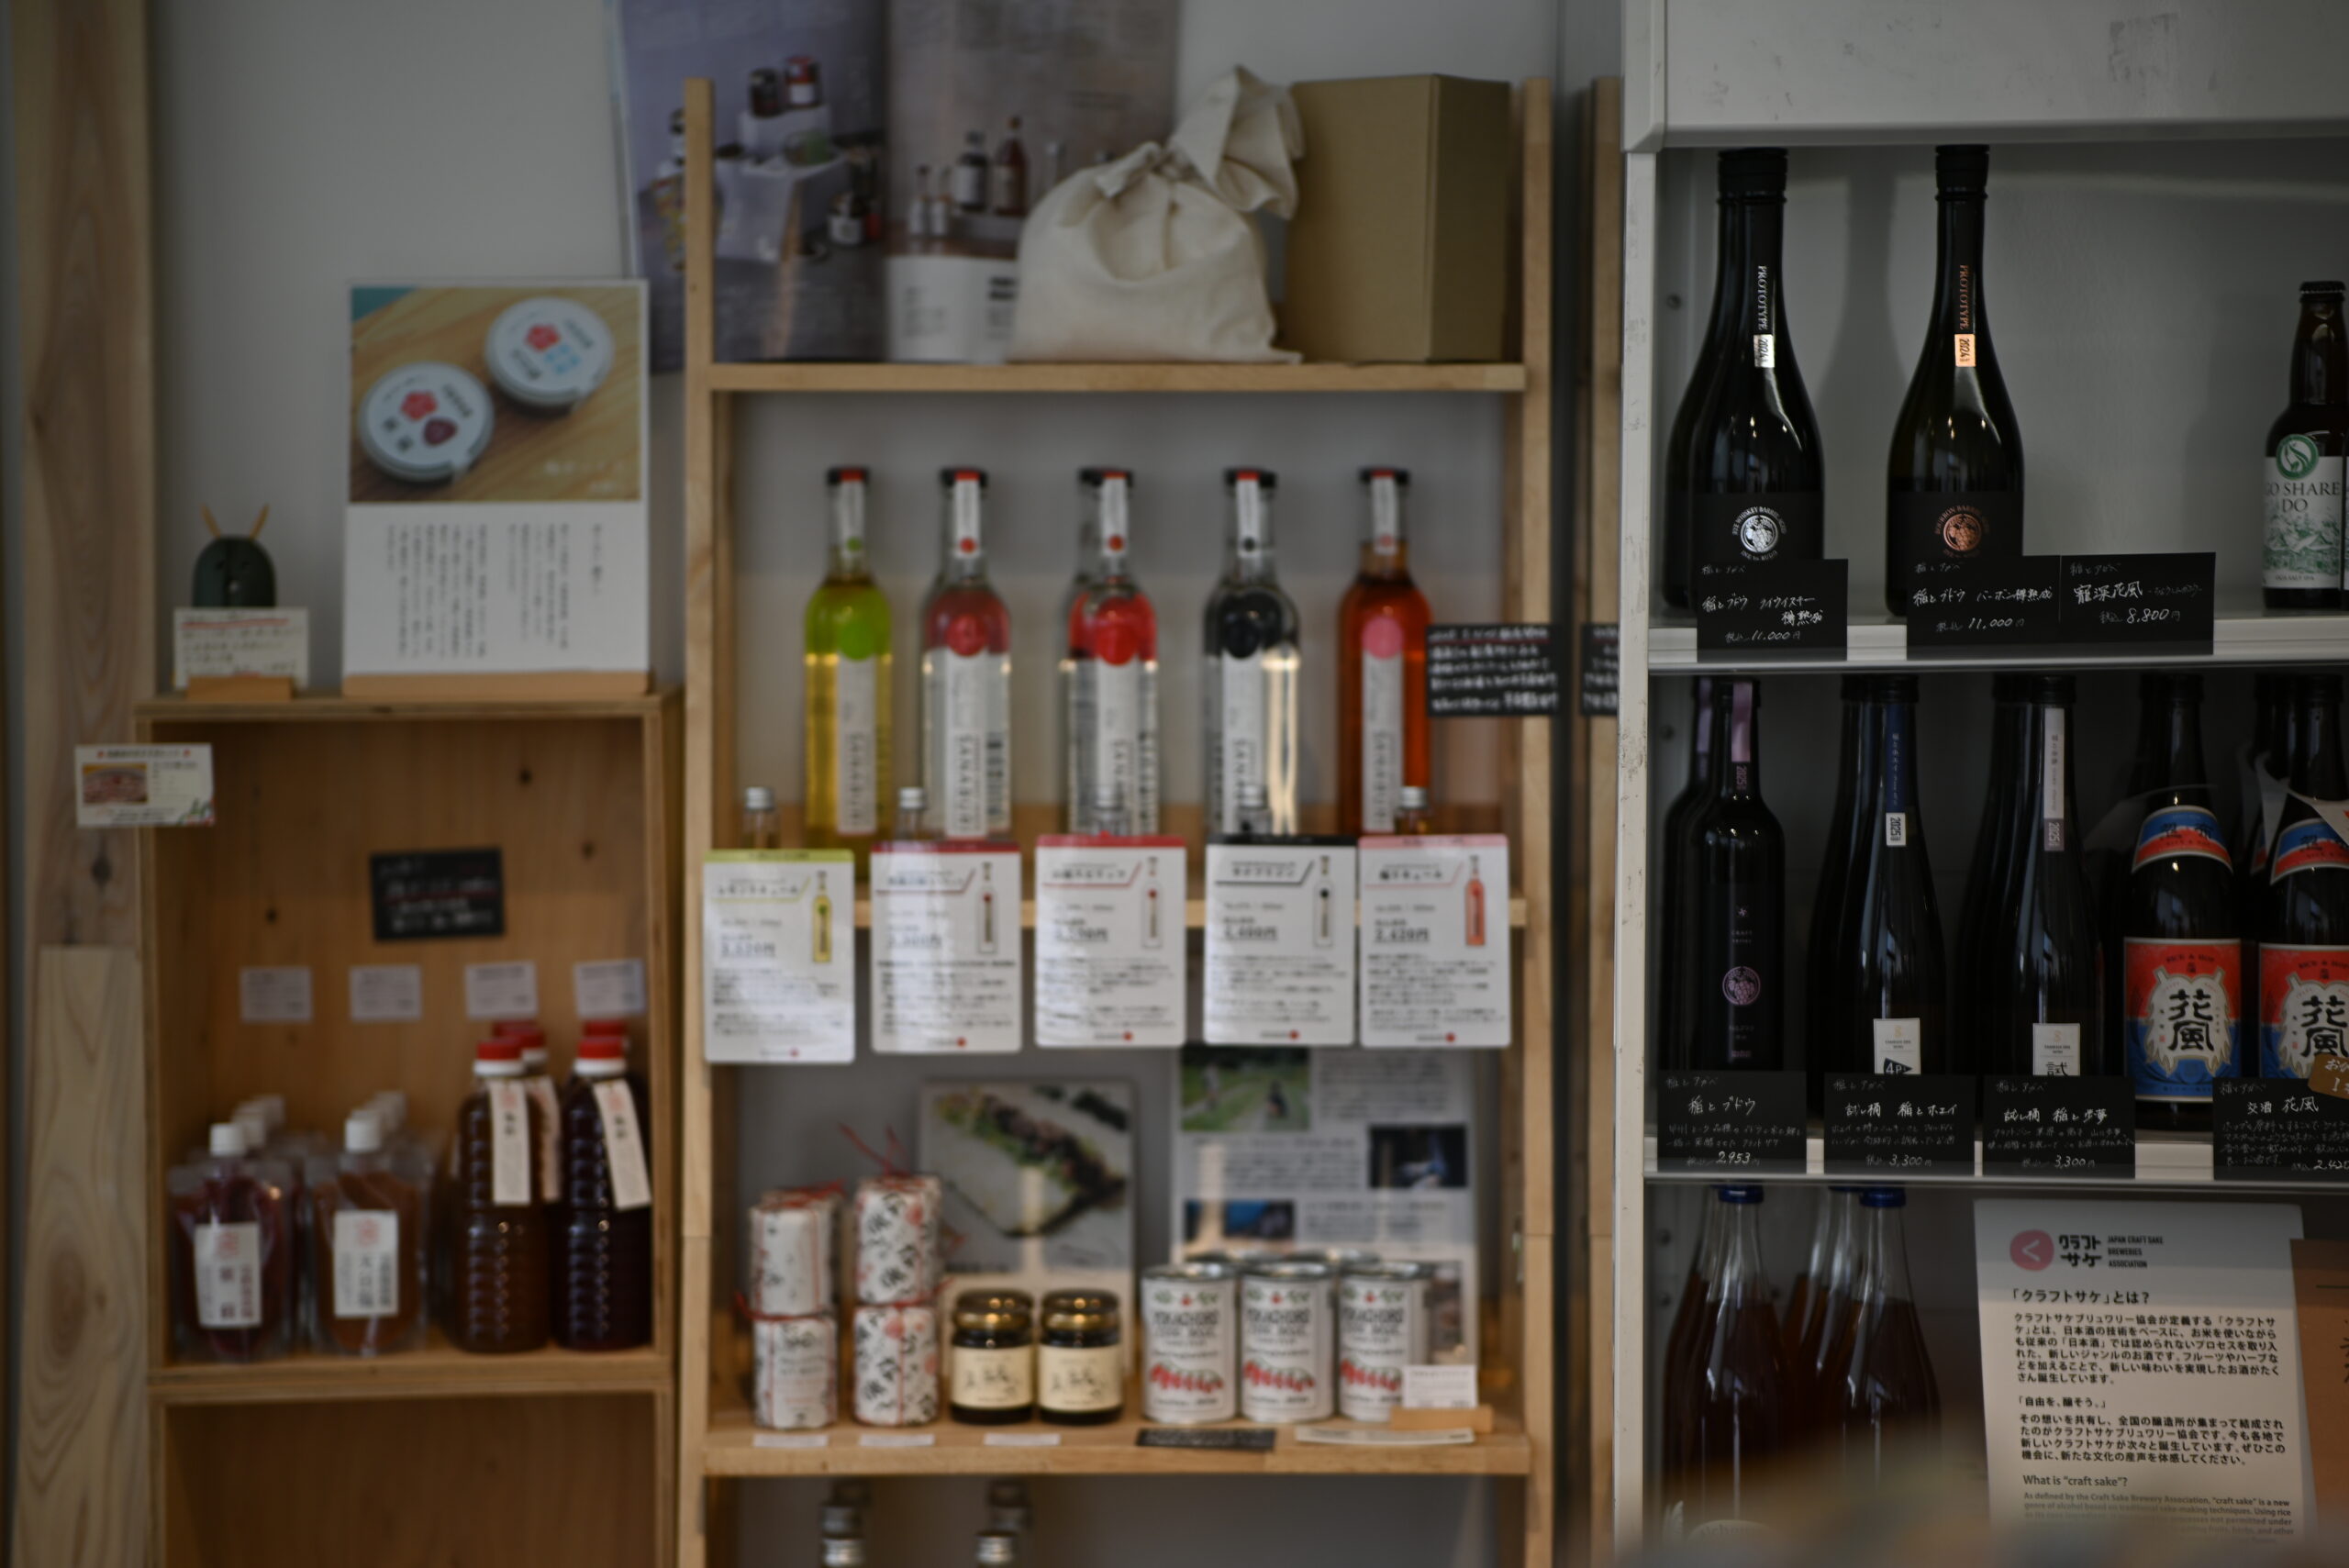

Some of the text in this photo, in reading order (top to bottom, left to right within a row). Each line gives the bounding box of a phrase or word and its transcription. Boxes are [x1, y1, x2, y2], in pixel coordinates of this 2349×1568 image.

[2283, 482, 2341, 495] SHARE
[2282, 497, 2308, 512] DO
[1889, 817, 1901, 836] 2025
[2169, 989, 2214, 1051] 花風
[2300, 995, 2349, 1057] 花風
[1688, 1095, 1756, 1116] 稲とブドウ
[2282, 1095, 2320, 1113] 花風
[2058, 1234, 2164, 1250] クラフト JAPAN CRAFT SAKE
[2108, 1248, 2143, 1256] BREWERIES
[2060, 1252, 2102, 1267] サケ
[2109, 1260, 2148, 1269] ASSOCIATION
[2018, 1373, 2115, 1385] さん誕生しています。
[2019, 1396, 2106, 1408] 「自由を、醸そう。」
[2023, 1475, 2051, 1485] What
[2053, 1475, 2061, 1485] is
[2034, 1492, 2064, 1500] defined
[2065, 1492, 2075, 1502] by
[2090, 1493, 2110, 1501] Craft
[2210, 1507, 2252, 1516] techniques.
[2254, 1507, 2276, 1517] Using
[2277, 1508, 2291, 1517] rice
[2274, 1527, 2294, 1535] other
